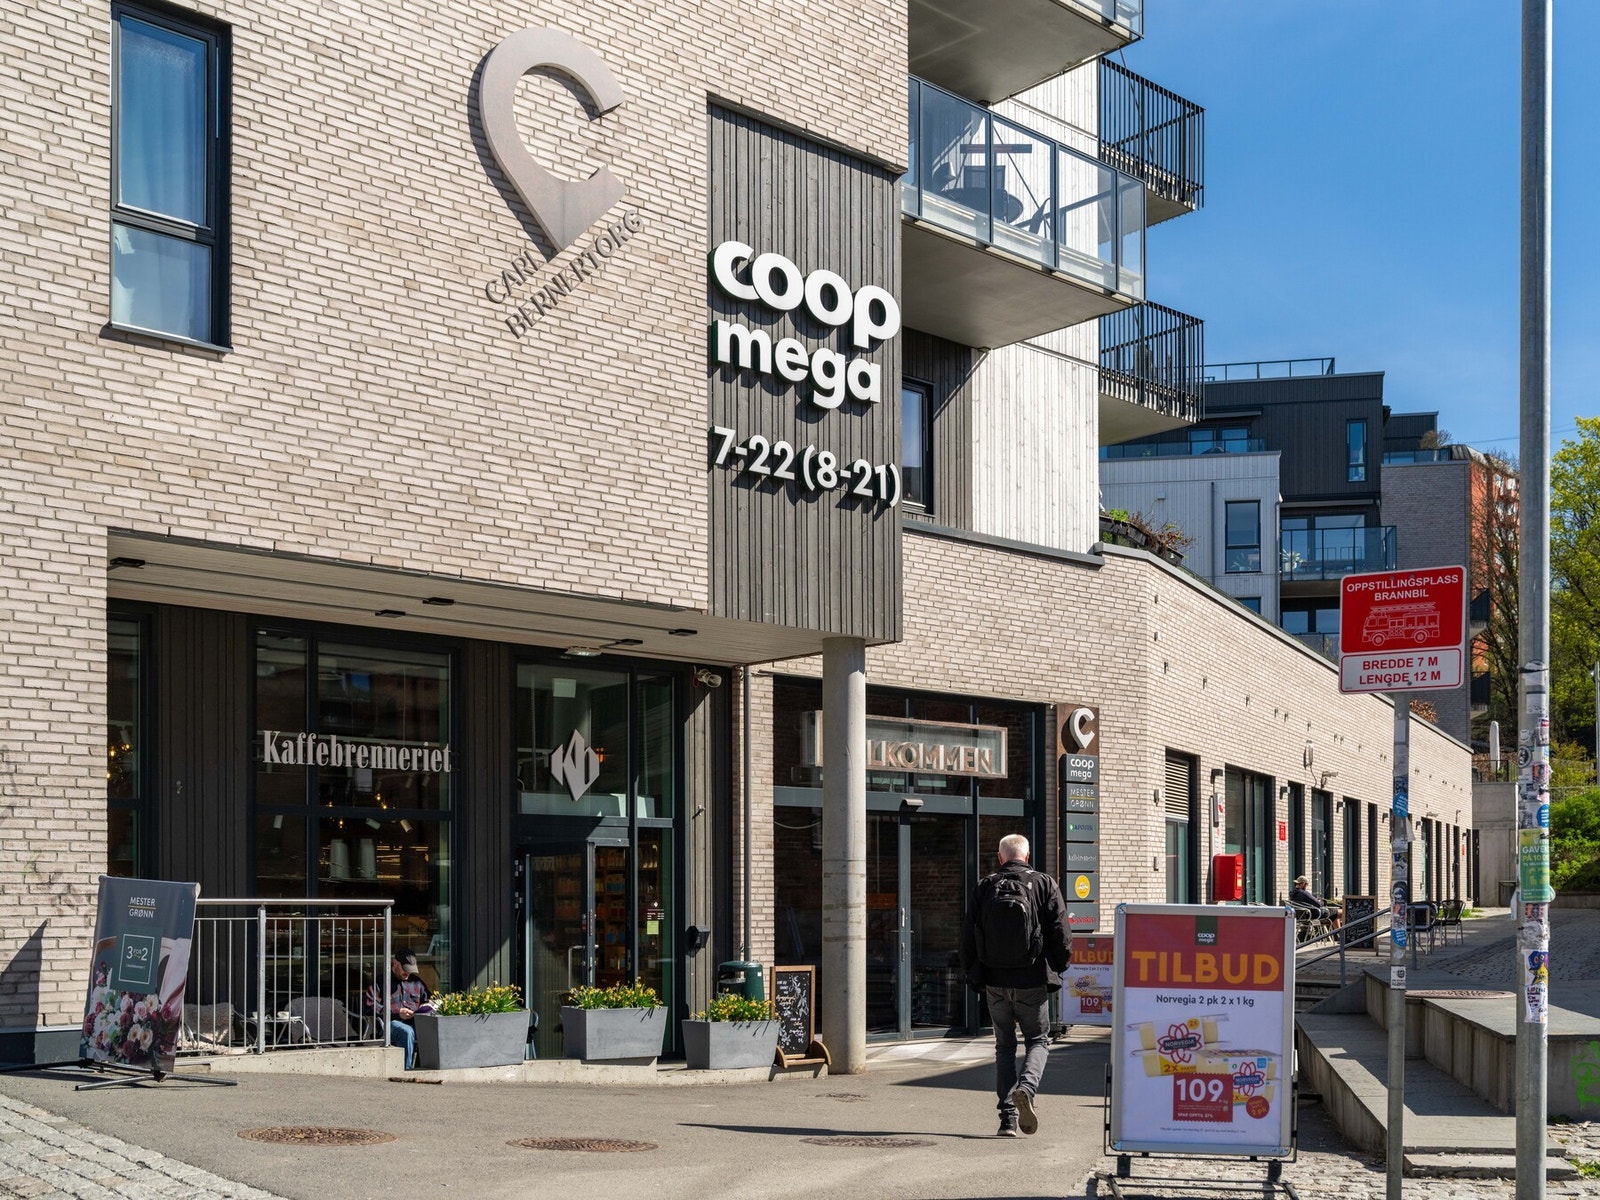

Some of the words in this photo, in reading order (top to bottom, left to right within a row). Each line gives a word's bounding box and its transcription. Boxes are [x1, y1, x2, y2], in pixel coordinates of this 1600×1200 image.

[485, 250, 544, 304] CARL
[713, 240, 901, 349] coop
[716, 319, 881, 409] mega
[714, 425, 795, 480] 7-22
[803, 443, 901, 508] (8-21)
[1346, 574, 1459, 593] OPPSTILLINGSPLASS
[1374, 589, 1430, 602] BRANNBIL
[1362, 658, 1414, 670] BREDDE
[1417, 657, 1425, 667] 7
[1428, 656, 1438, 666] M
[1359, 672, 1410, 685] LENGDE
[1414, 671, 1427, 681] 12
[1431, 670, 1441, 680] M
[262, 730, 452, 773] Kaffebrenneriet
[1070, 758, 1095, 769] coop
[1070, 770, 1092, 780] mega
[129, 897, 156, 906] MESTER
[129, 908, 154, 918] GRØNN
[126, 945, 133, 960] 3
[141, 947, 149, 961] 2
[1132, 951, 1280, 985] TILBUD
[1081, 997, 1099, 1006] 109
[1156, 995, 1197, 1005] Norvegia
[1199, 996, 1205, 1005] 2
[1207, 996, 1218, 1007] pk
[1220, 997, 1227, 1005] 2
[1236, 997, 1241, 1005] 1
[1242, 997, 1255, 1007] kg
[1164, 1040, 1196, 1048] NORVEGIA
[1176, 1078, 1224, 1102] 109
